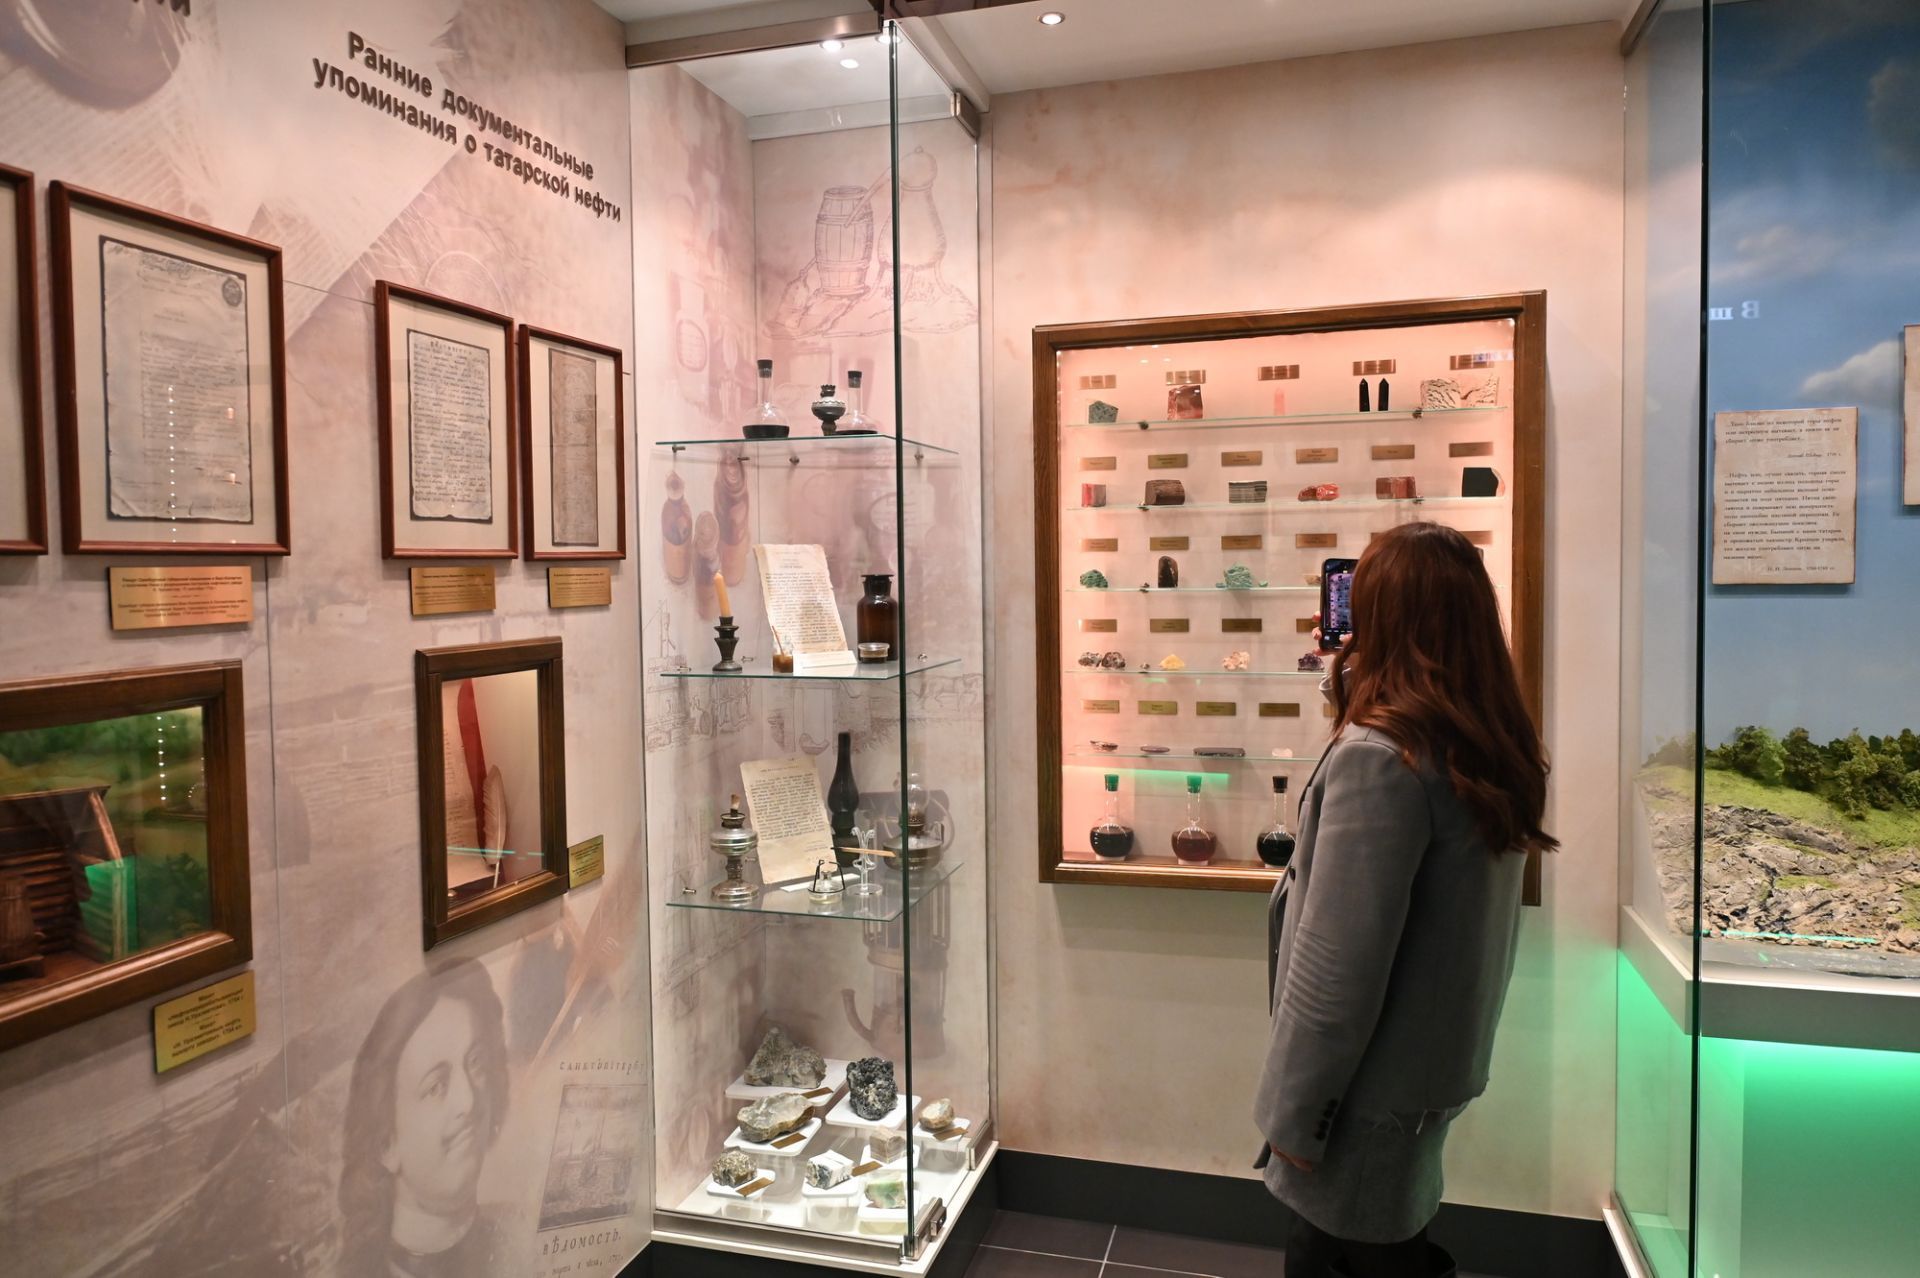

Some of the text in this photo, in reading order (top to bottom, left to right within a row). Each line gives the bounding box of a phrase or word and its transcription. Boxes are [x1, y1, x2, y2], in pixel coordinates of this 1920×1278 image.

[312, 57, 621, 223] упоминания о татарской нефти
[347, 31, 594, 181] Ранние документальные
